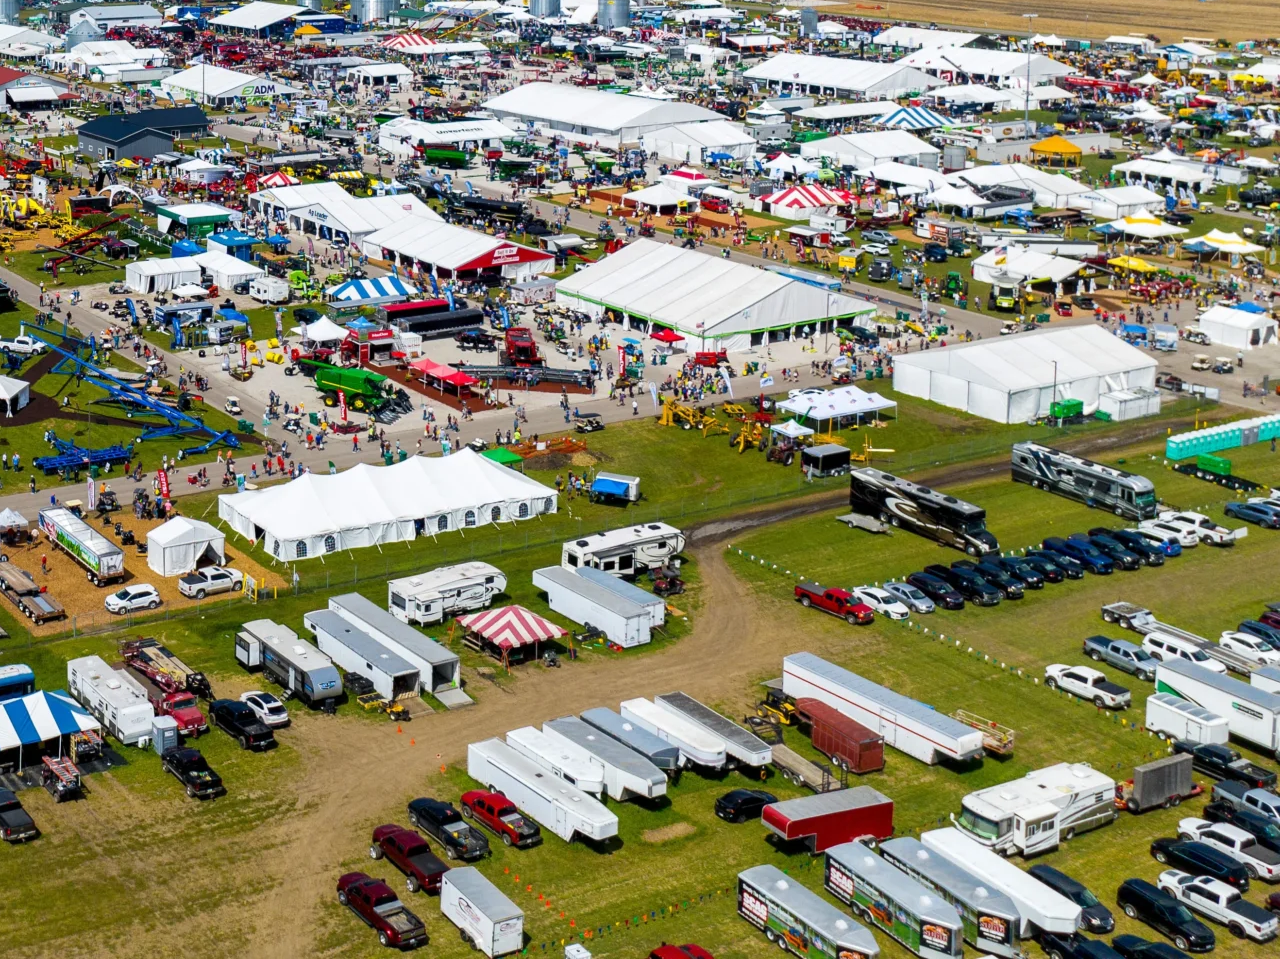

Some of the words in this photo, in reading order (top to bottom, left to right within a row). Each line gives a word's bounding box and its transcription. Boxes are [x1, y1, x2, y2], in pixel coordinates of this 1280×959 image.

[254, 84, 276, 95] ADM
[436, 127, 483, 135] Unverferth
[308, 208, 314, 217] Ag
[314, 209, 328, 219] Leader
[159, 472, 167, 494] ISUZU
[830, 867, 854, 892] SCAG
[742, 891, 767, 916] SCAG
